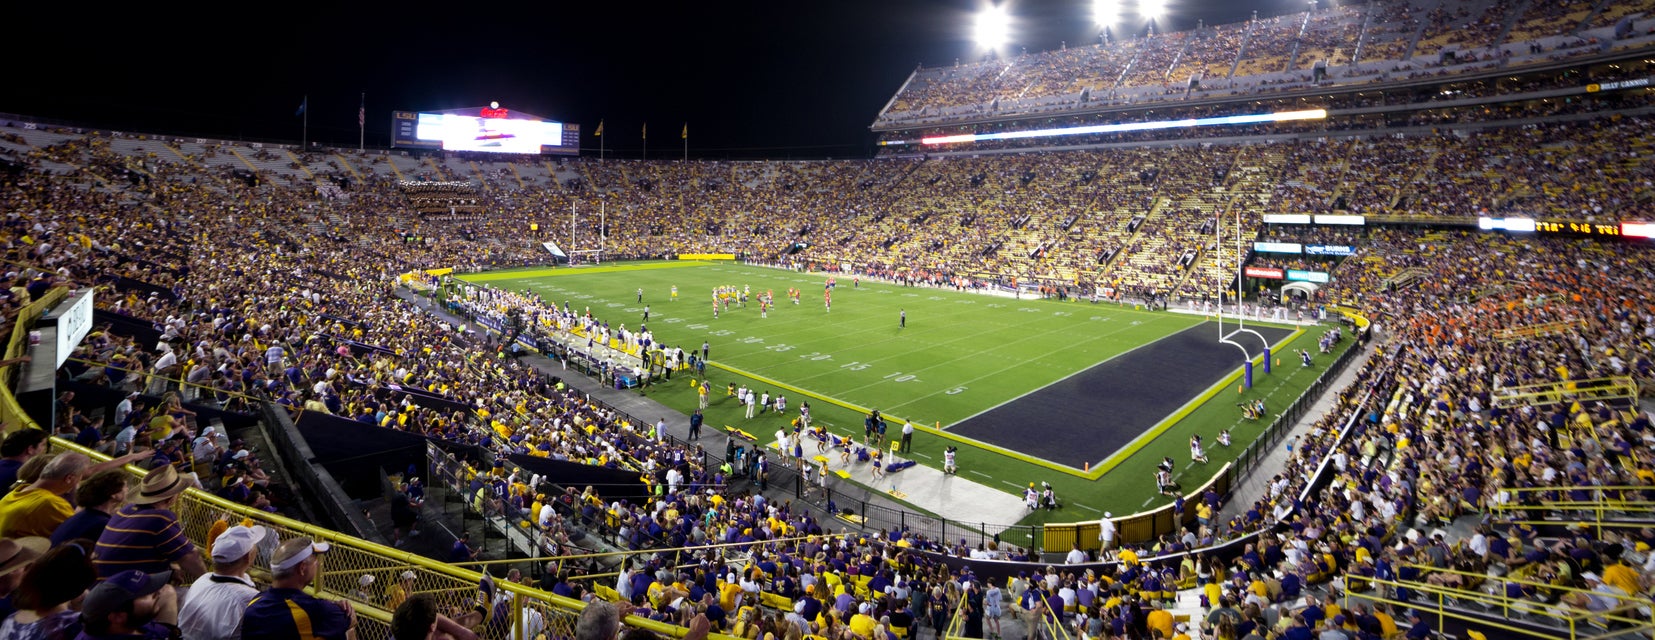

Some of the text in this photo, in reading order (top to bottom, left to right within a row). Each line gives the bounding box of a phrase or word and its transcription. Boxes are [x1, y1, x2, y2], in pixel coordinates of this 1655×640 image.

[1620, 78, 1649, 88] CANNON
[396, 112, 417, 120] LSU
[563, 123, 579, 131] LSU
[1325, 244, 1351, 253] BURNS
[840, 361, 871, 371] 15
[883, 372, 917, 382] 10
[945, 386, 968, 395] 5
